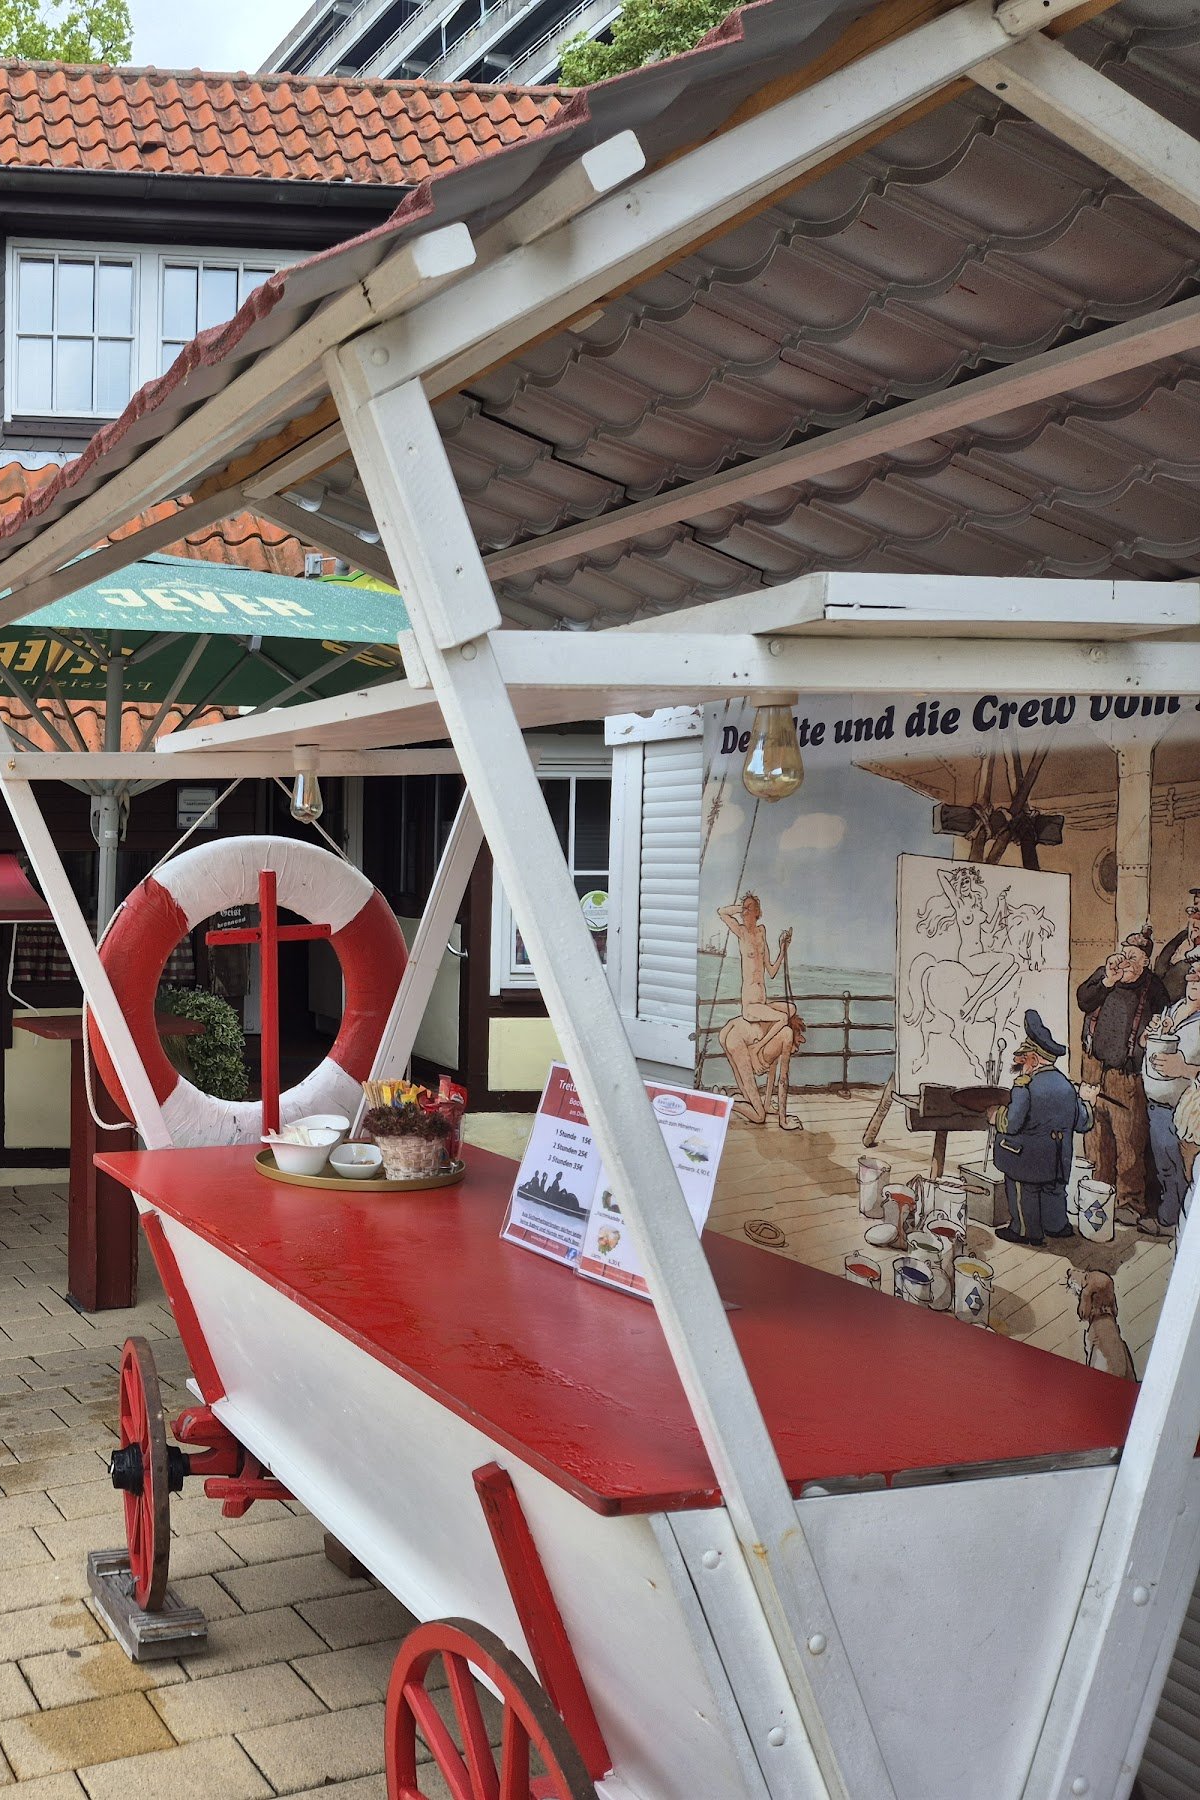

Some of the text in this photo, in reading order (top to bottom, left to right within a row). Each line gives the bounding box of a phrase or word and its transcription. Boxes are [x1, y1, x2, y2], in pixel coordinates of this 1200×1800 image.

[97, 587, 314, 617] JEVER
[834, 705, 895, 743] und
[905, 704, 961, 738] die
[972, 695, 1077, 733] Crew
[559, 1129, 577, 1141] Stunde
[582, 1136, 592, 1145] 15€
[556, 1143, 578, 1155] Stunden
[578, 1149, 588, 1158] 25€
[551, 1155, 573, 1168] Stunden
